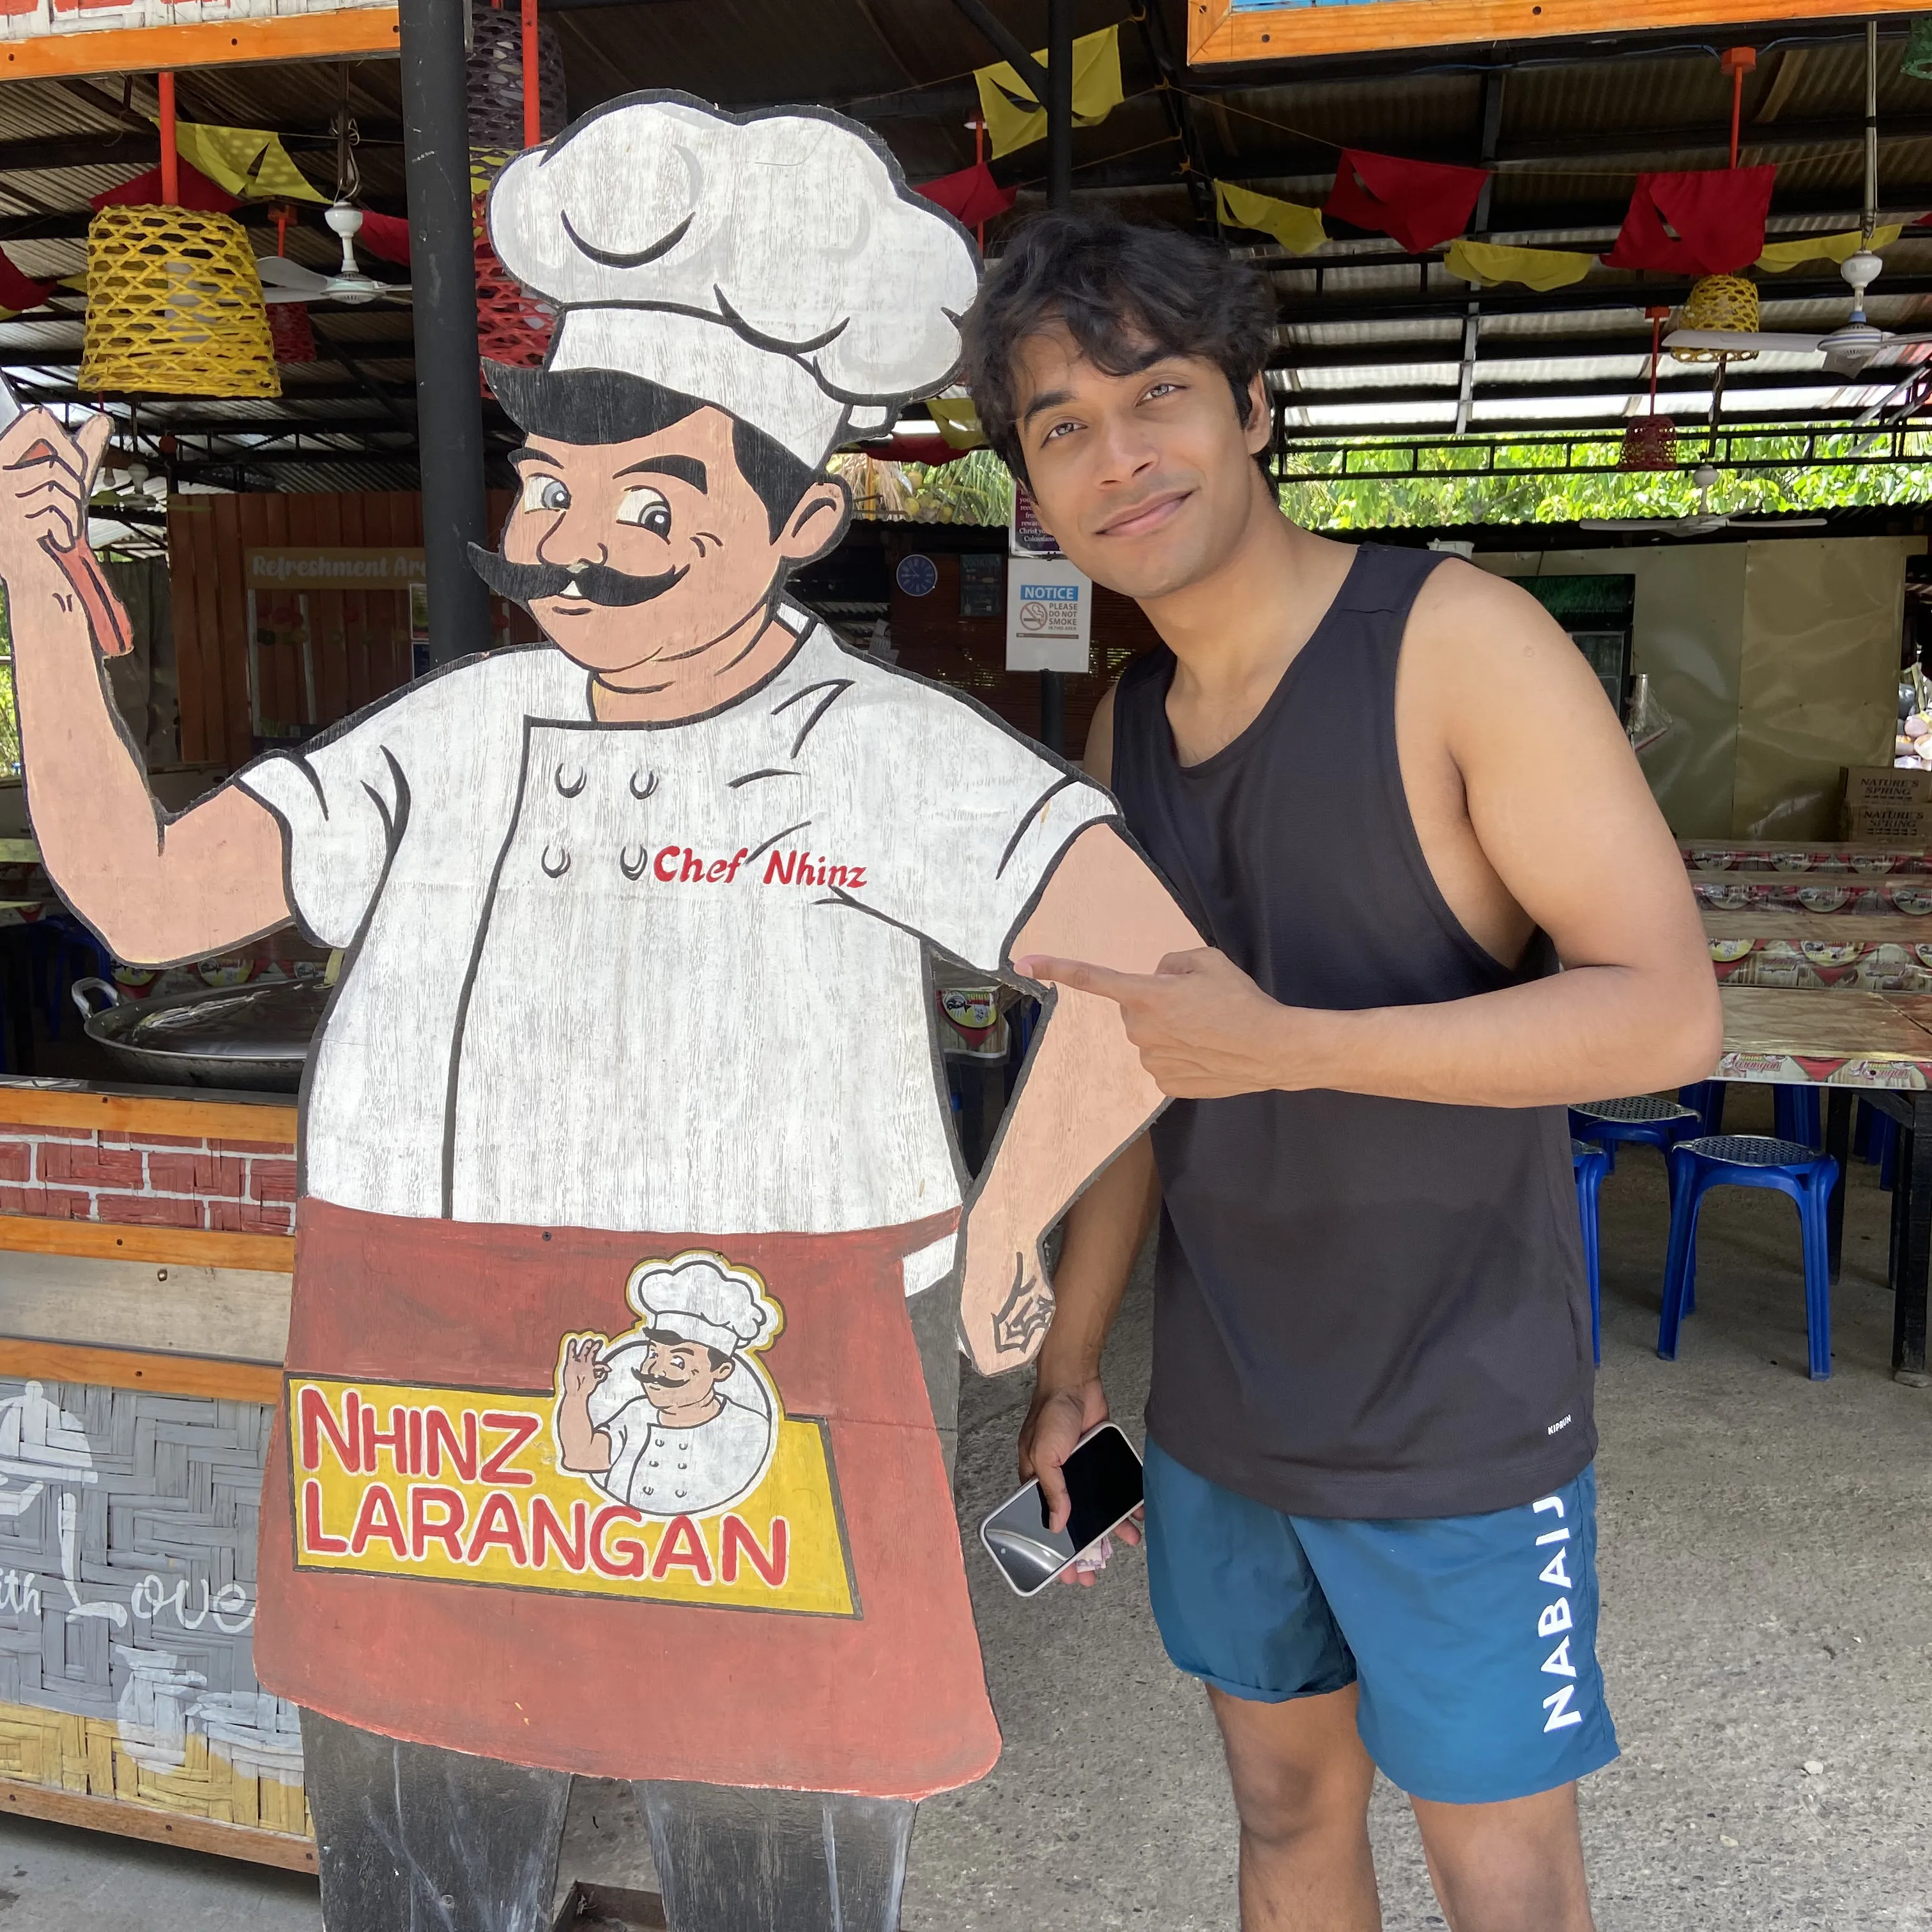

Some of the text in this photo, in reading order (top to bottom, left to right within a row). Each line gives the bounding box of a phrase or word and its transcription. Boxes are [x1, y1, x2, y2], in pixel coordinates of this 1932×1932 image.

[252, 555, 387, 581] Refreshment
[1025, 586, 1073, 599] NOTICE
[1860, 778, 1919, 787] NATURE'S
[1866, 786, 1911, 795] SPRING
[654, 845, 868, 888] Chef Nhinz
[298, 1384, 542, 1487] NHINZ
[1547, 1414, 1572, 1436] KIPRUN
[302, 1477, 791, 1588] LARANGAN
[57, 1492, 256, 1634] Love
[1532, 1496, 1583, 1734] NABAIJ
